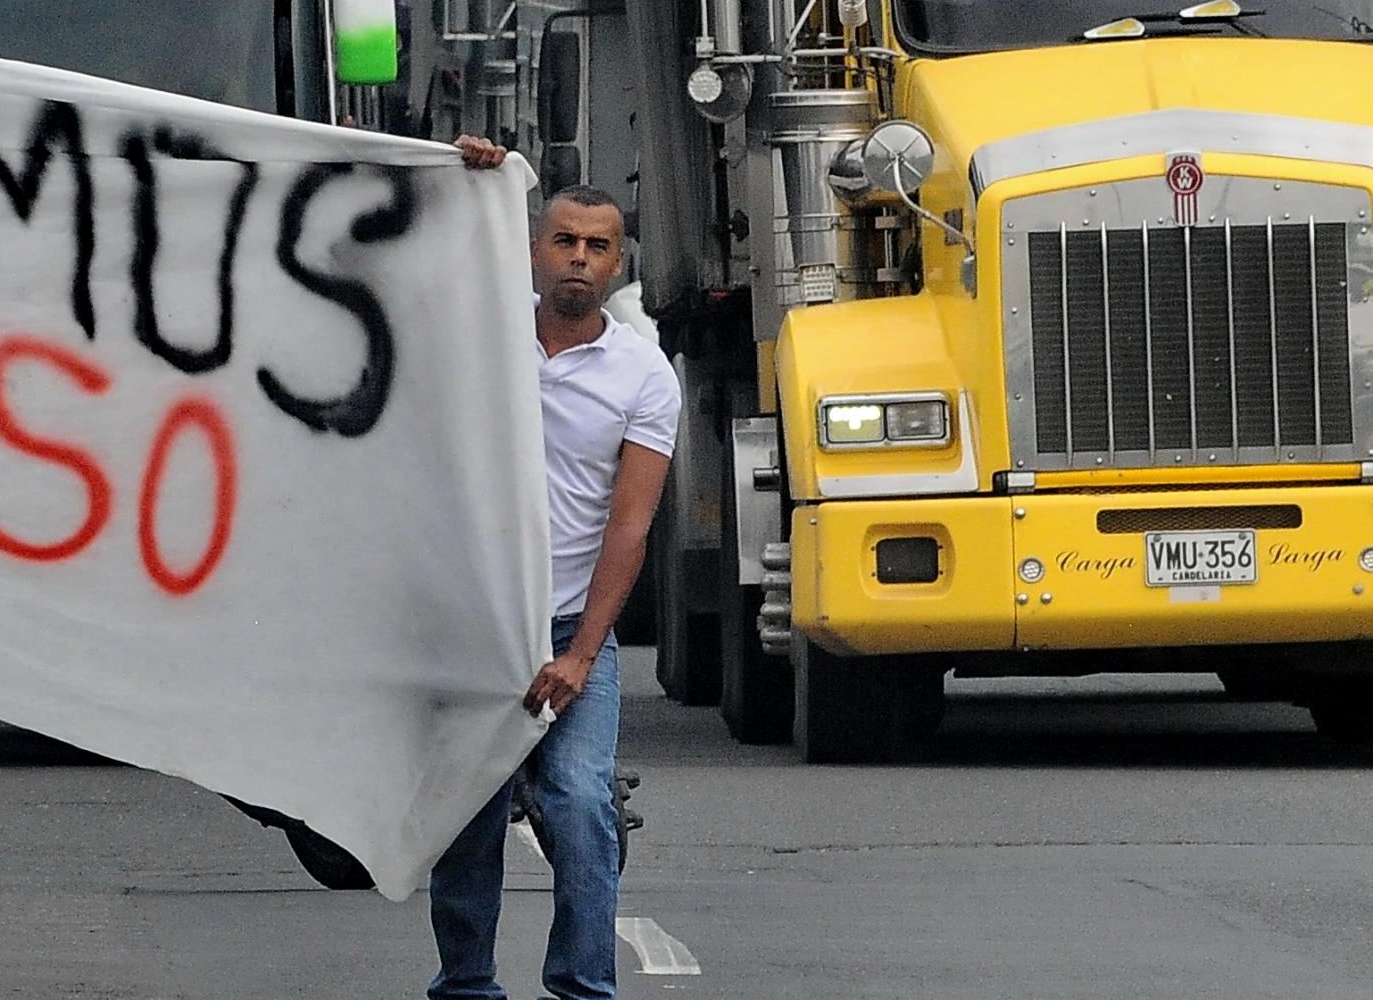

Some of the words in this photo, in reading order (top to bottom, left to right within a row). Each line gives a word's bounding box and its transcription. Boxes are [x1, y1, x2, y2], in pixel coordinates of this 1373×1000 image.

[1054, 551, 1137, 579] Carga
[1266, 543, 1345, 573] Larga
[1172, 571, 1232, 581] CANDELARIA
